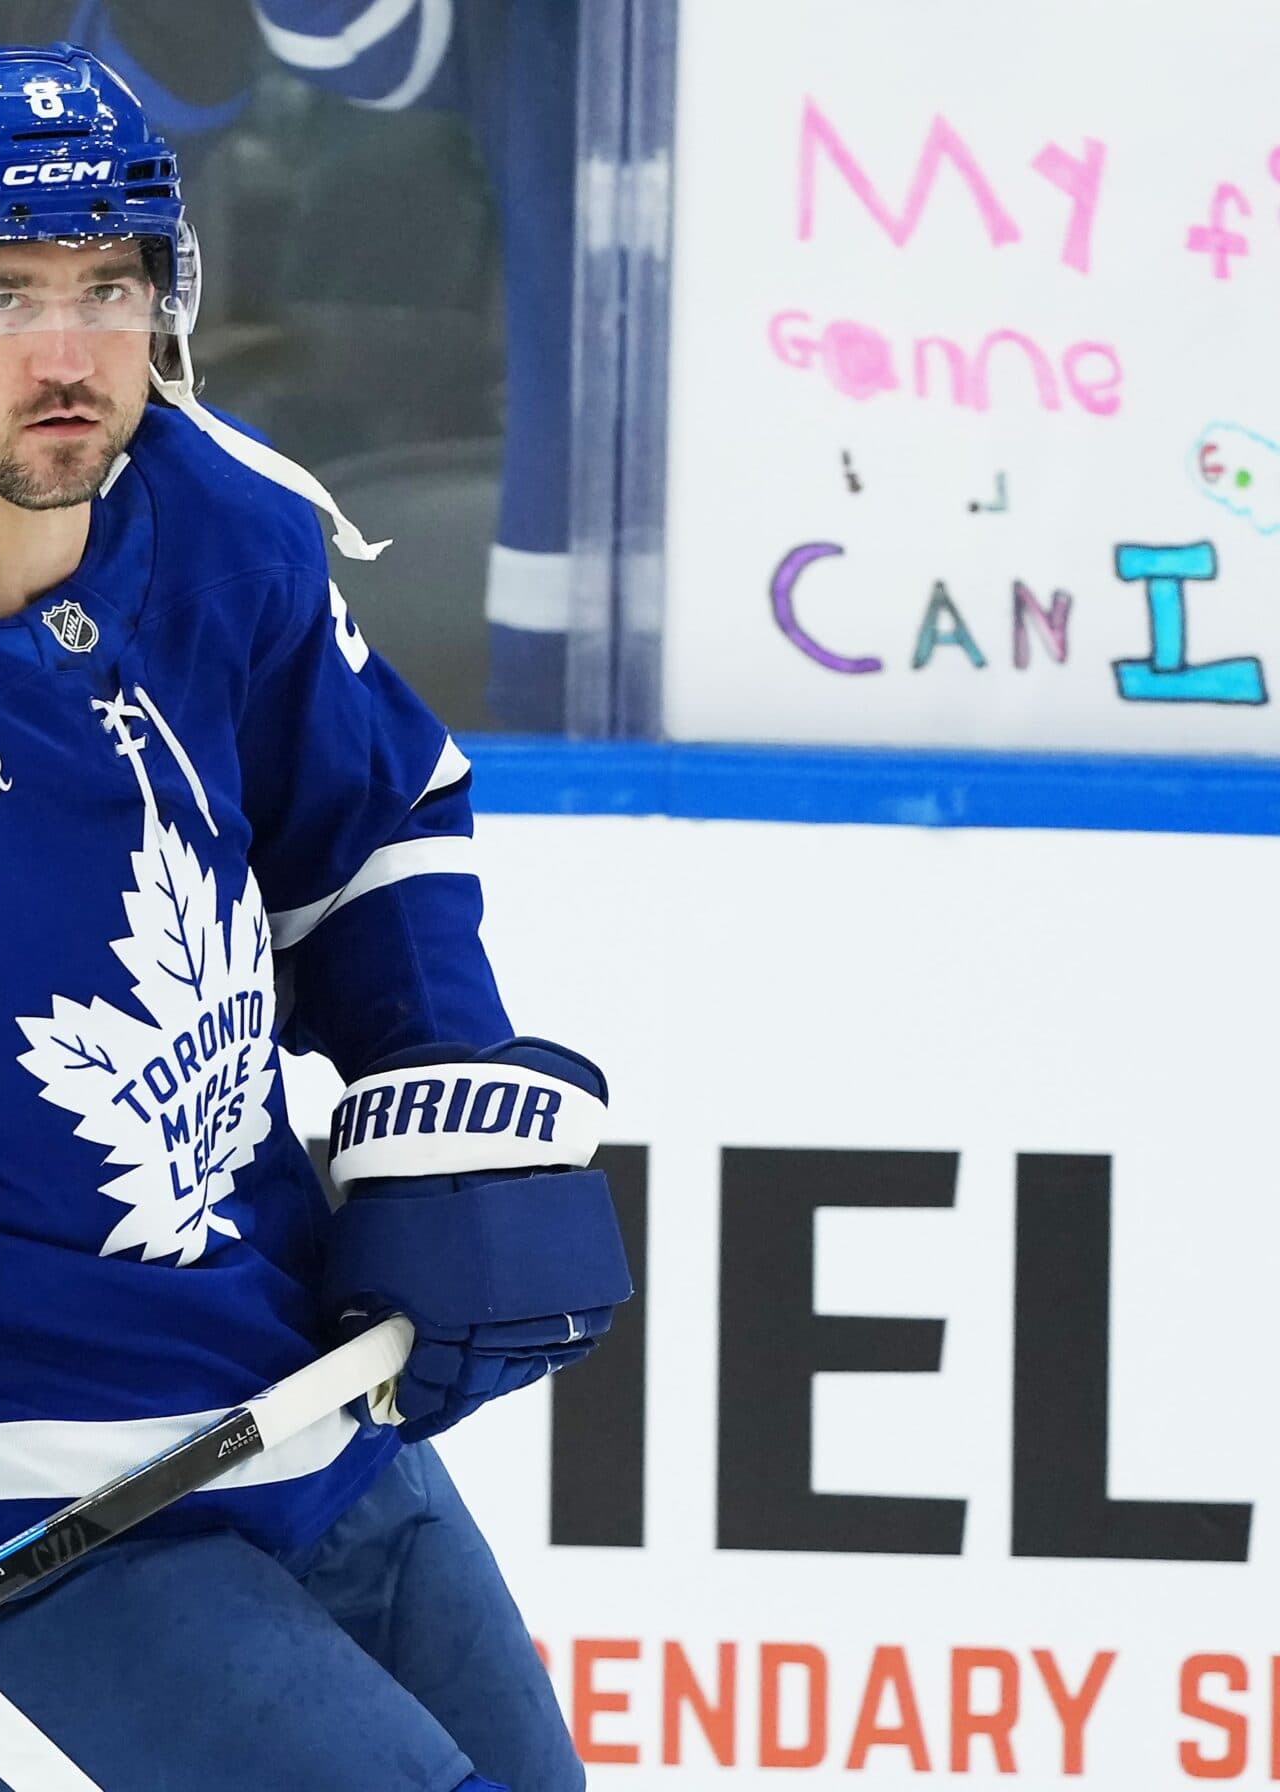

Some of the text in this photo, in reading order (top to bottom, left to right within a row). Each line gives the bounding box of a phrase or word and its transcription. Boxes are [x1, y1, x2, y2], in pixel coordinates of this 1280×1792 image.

[23, 77, 65, 118] 8
[2, 160, 112, 186] CCM
[797, 95, 1280, 278] My f
[770, 540, 1268, 705] CAN I
[111, 990, 263, 1124] TORONTO
[160, 1043, 251, 1153] MAPLE
[169, 1091, 246, 1201] LEAFS
[328, 1078, 563, 1162] ARRIOR
[533, 1637, 1280, 1784] ENDARY S
